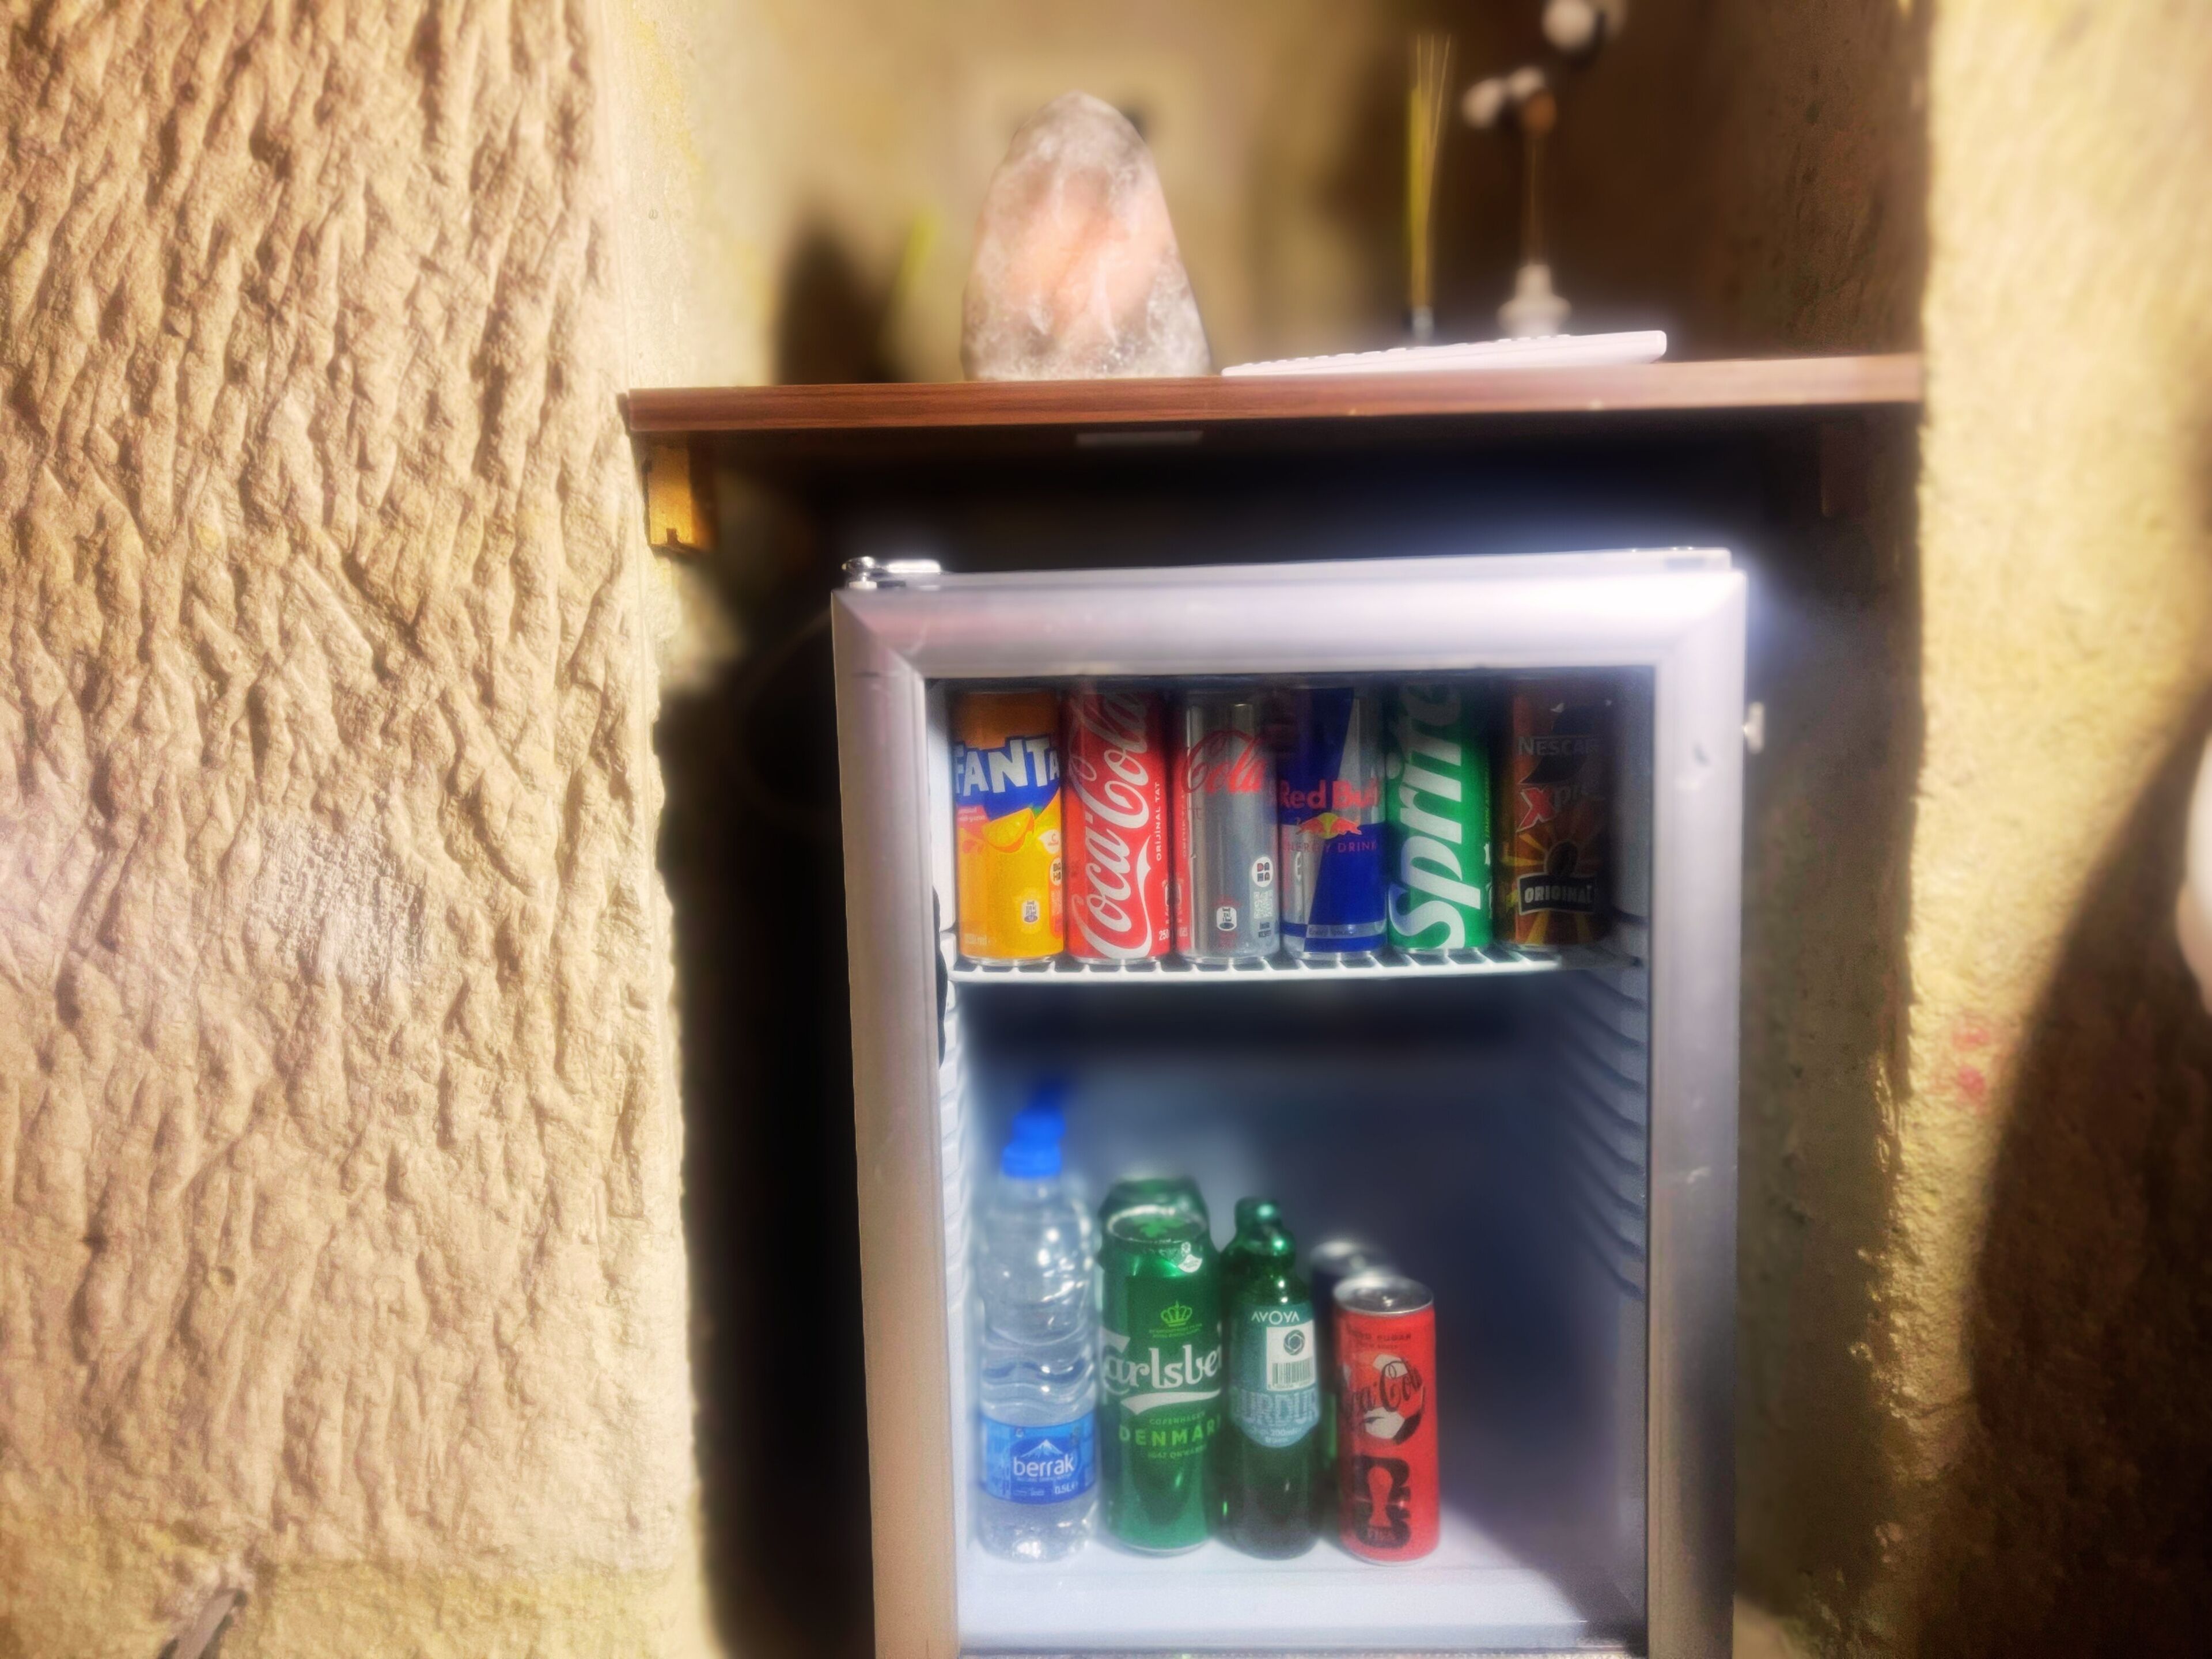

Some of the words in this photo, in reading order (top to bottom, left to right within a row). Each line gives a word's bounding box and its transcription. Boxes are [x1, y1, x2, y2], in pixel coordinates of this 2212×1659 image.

[953, 737, 1060, 797] FANTA
[1280, 779, 1327, 809] Red
[1013, 1453, 1075, 1478] berrak
